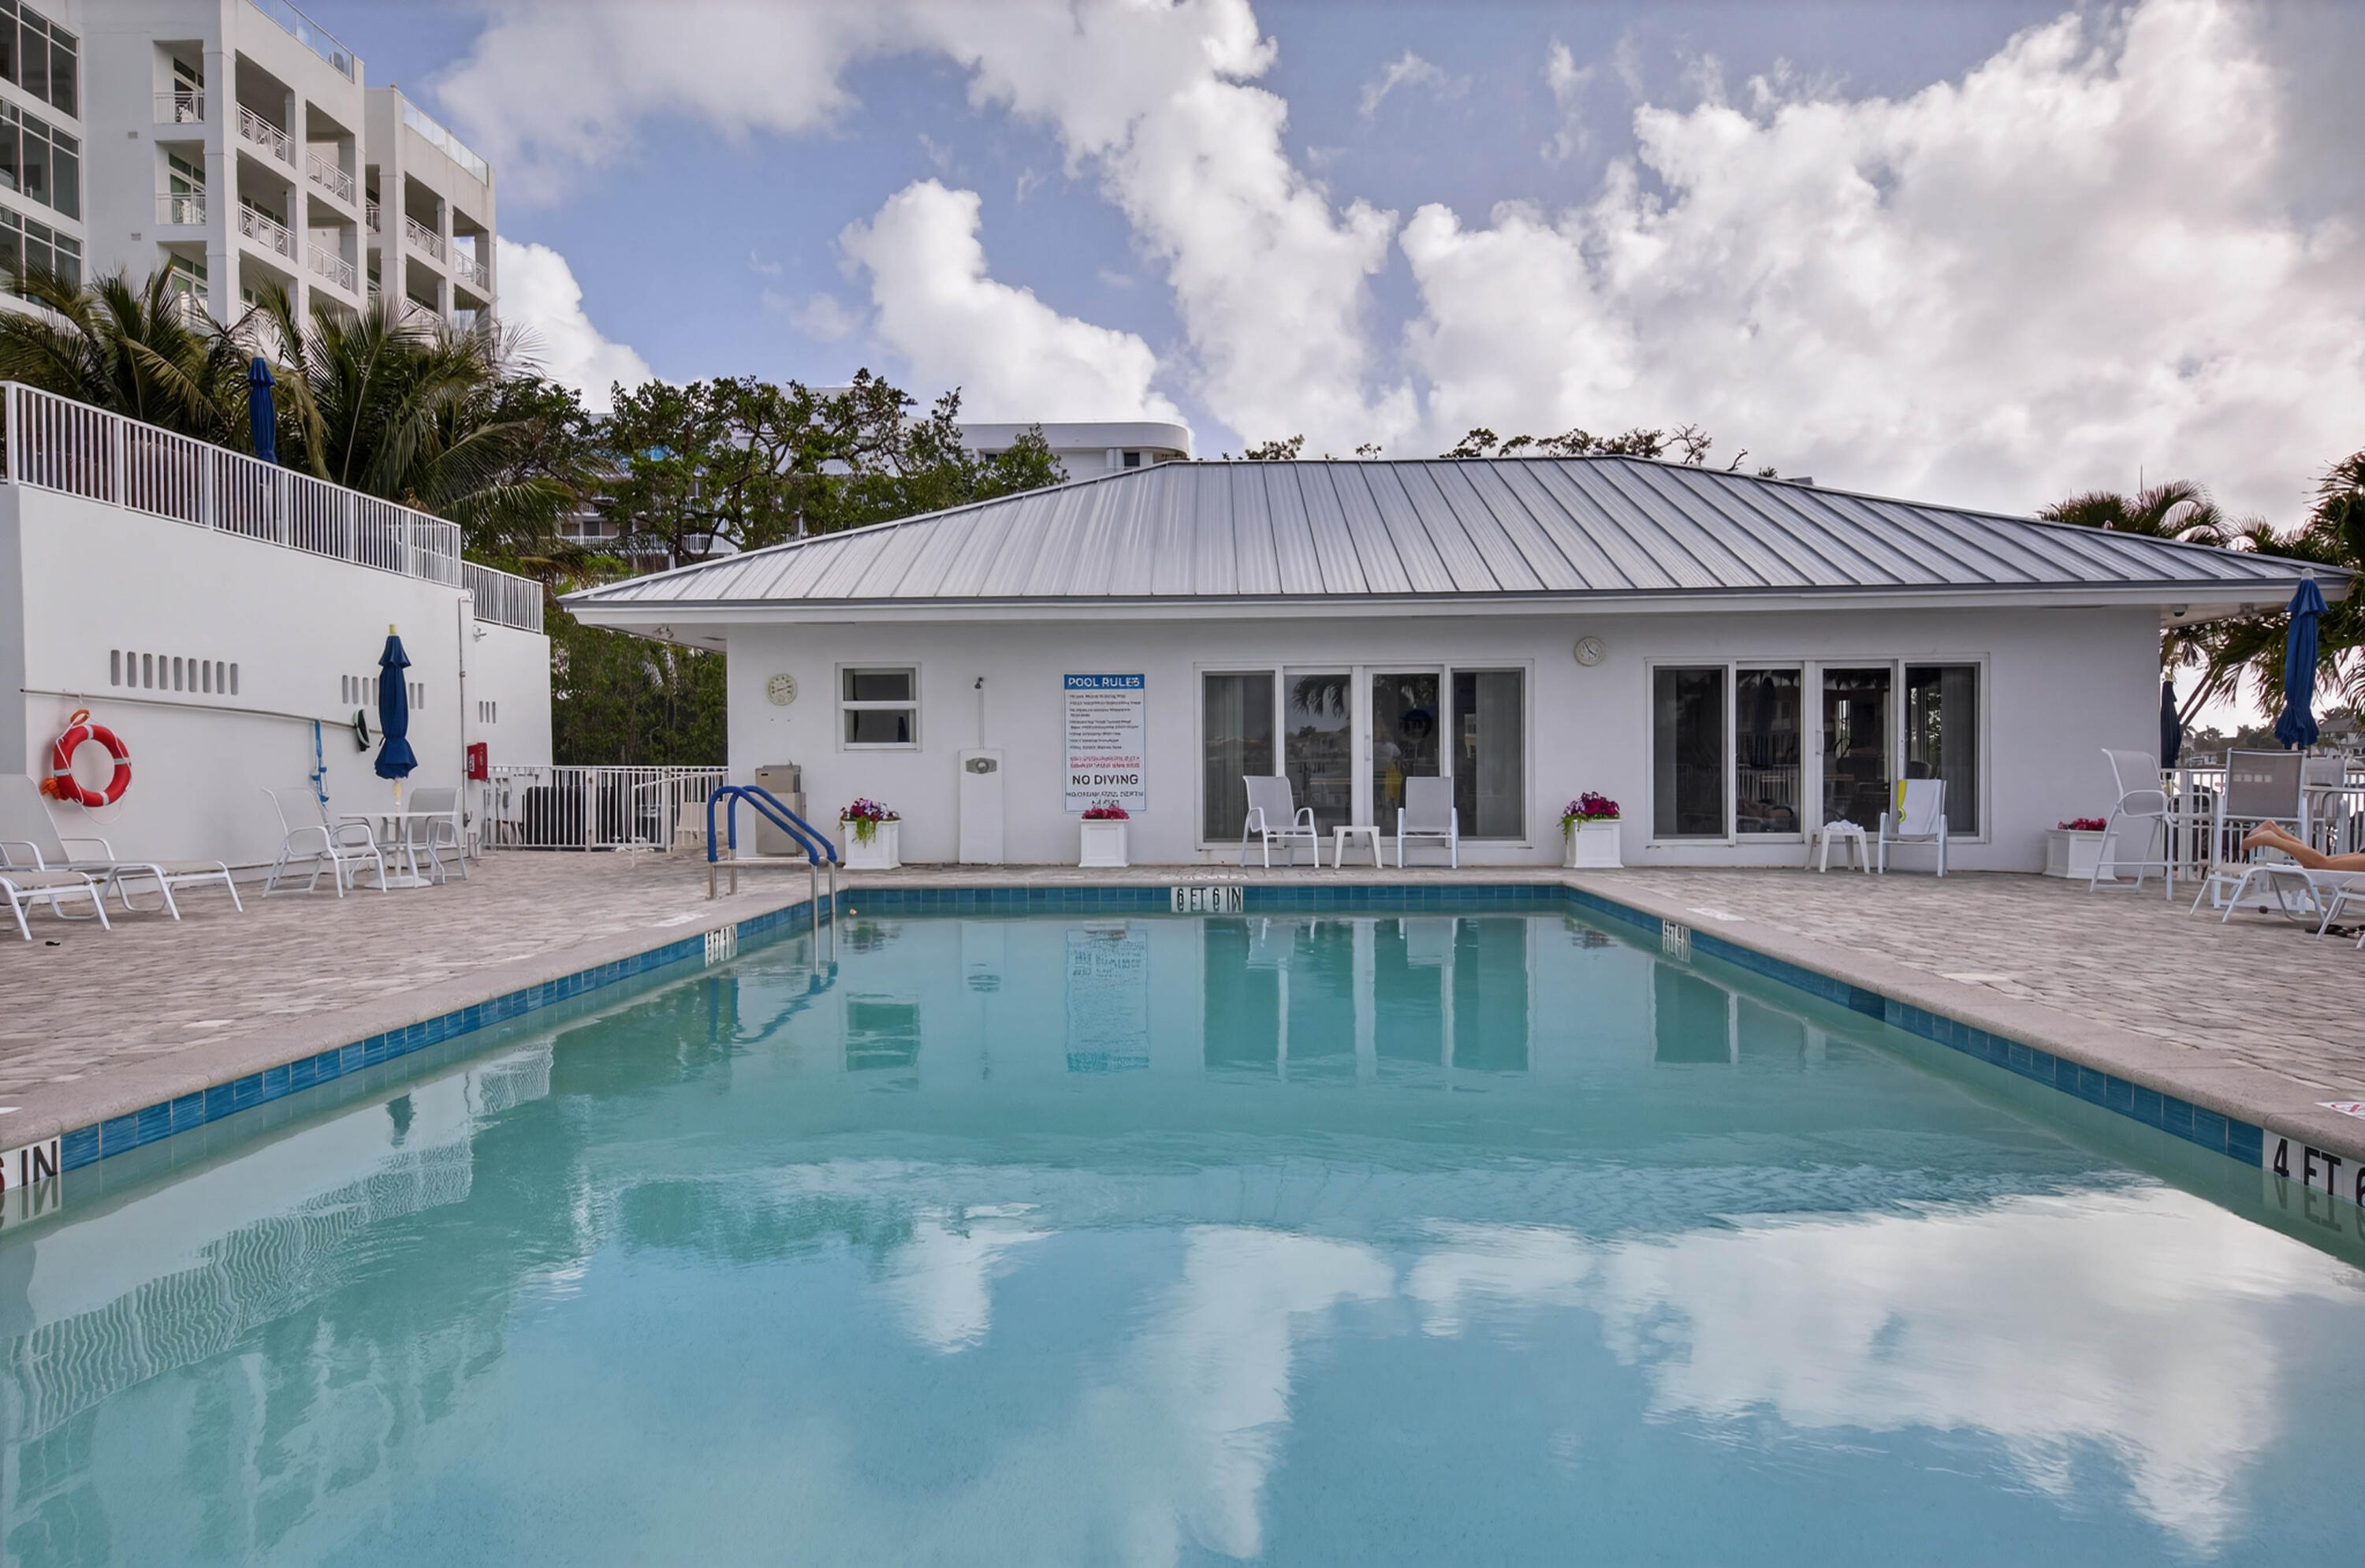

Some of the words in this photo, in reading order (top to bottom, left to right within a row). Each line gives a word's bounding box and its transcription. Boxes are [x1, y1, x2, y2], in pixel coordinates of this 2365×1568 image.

[1068, 677, 1099, 687] POOL
[1102, 677, 1140, 687] RULES
[1072, 774, 1090, 785] NO
[1094, 774, 1138, 785] DIVING
[21, 1141, 58, 1186] IN
[2274, 1138, 2289, 1177] 4
[2304, 1146, 2341, 1196] FT
